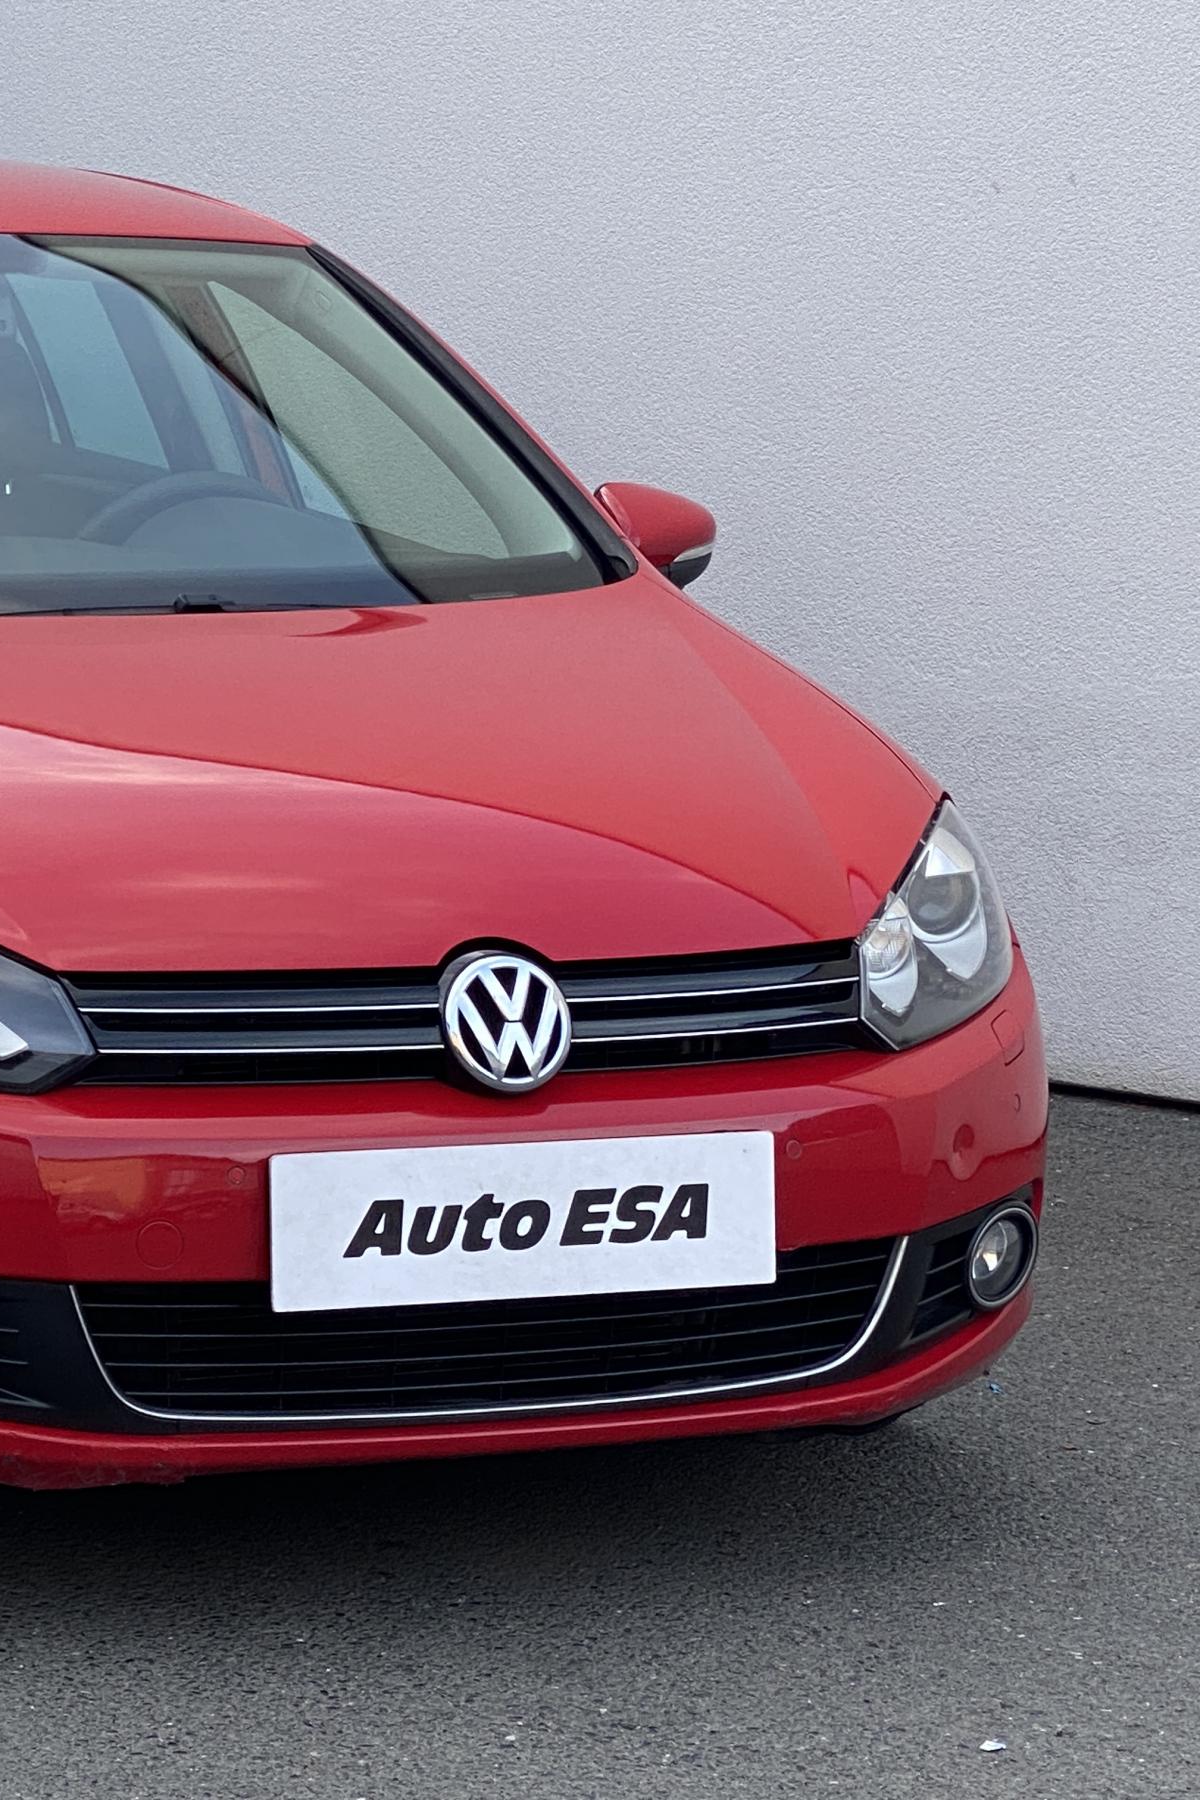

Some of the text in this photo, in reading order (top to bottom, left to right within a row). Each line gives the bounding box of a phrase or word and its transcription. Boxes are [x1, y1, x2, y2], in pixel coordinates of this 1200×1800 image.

[454, 962, 564, 1083] VW
[342, 1183, 709, 1259] Auto ESA
